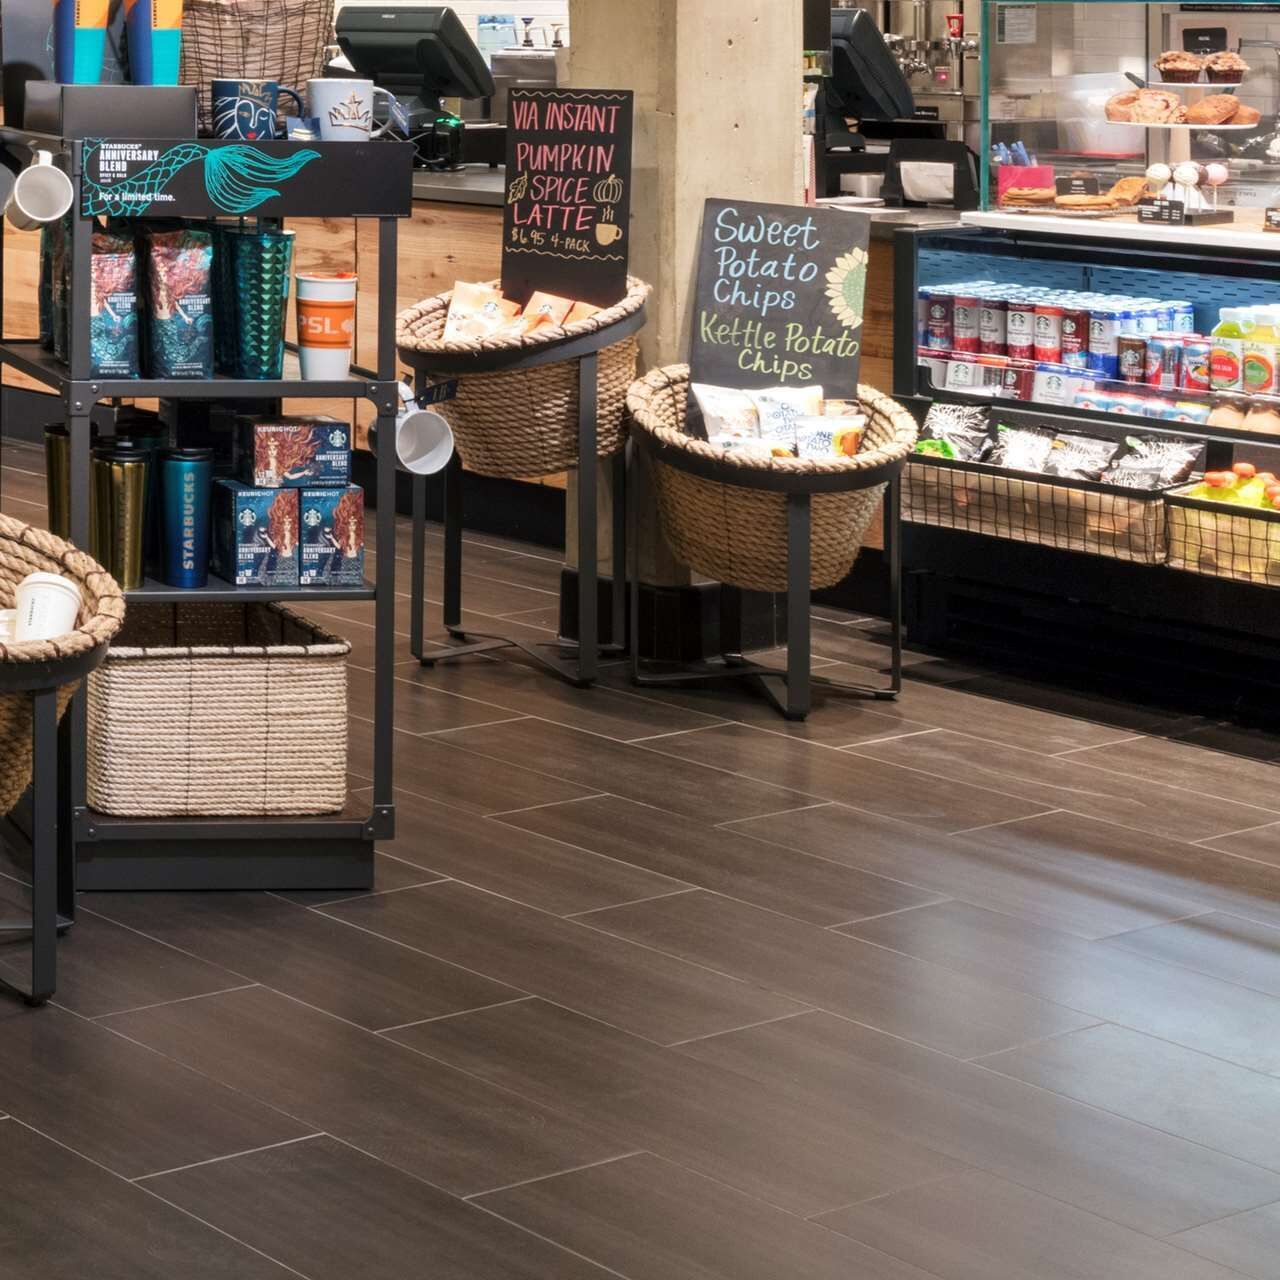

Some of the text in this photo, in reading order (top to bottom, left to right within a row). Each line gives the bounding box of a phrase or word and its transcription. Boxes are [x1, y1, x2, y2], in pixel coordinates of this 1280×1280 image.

[512, 101, 621, 133] VIA INSTANT
[100, 150, 159, 161] ANNIVERSARY
[100, 161, 127, 172] BLEND
[517, 142, 615, 174] PUMPKIN
[99, 192, 113, 201] For
[122, 192, 152, 201] limited
[154, 192, 176, 202] time.
[530, 175, 590, 204] SPICE
[513, 203, 597, 231] LATTE
[714, 207, 820, 250] Sweet
[551, 232, 590, 253] 4-PACK
[714, 246, 818, 282] Potato
[713, 278, 796, 317] Chips
[700, 310, 860, 357] Kettle Potato
[737, 348, 813, 382] Chips
[183, 472, 195, 569] STARBUCKS
